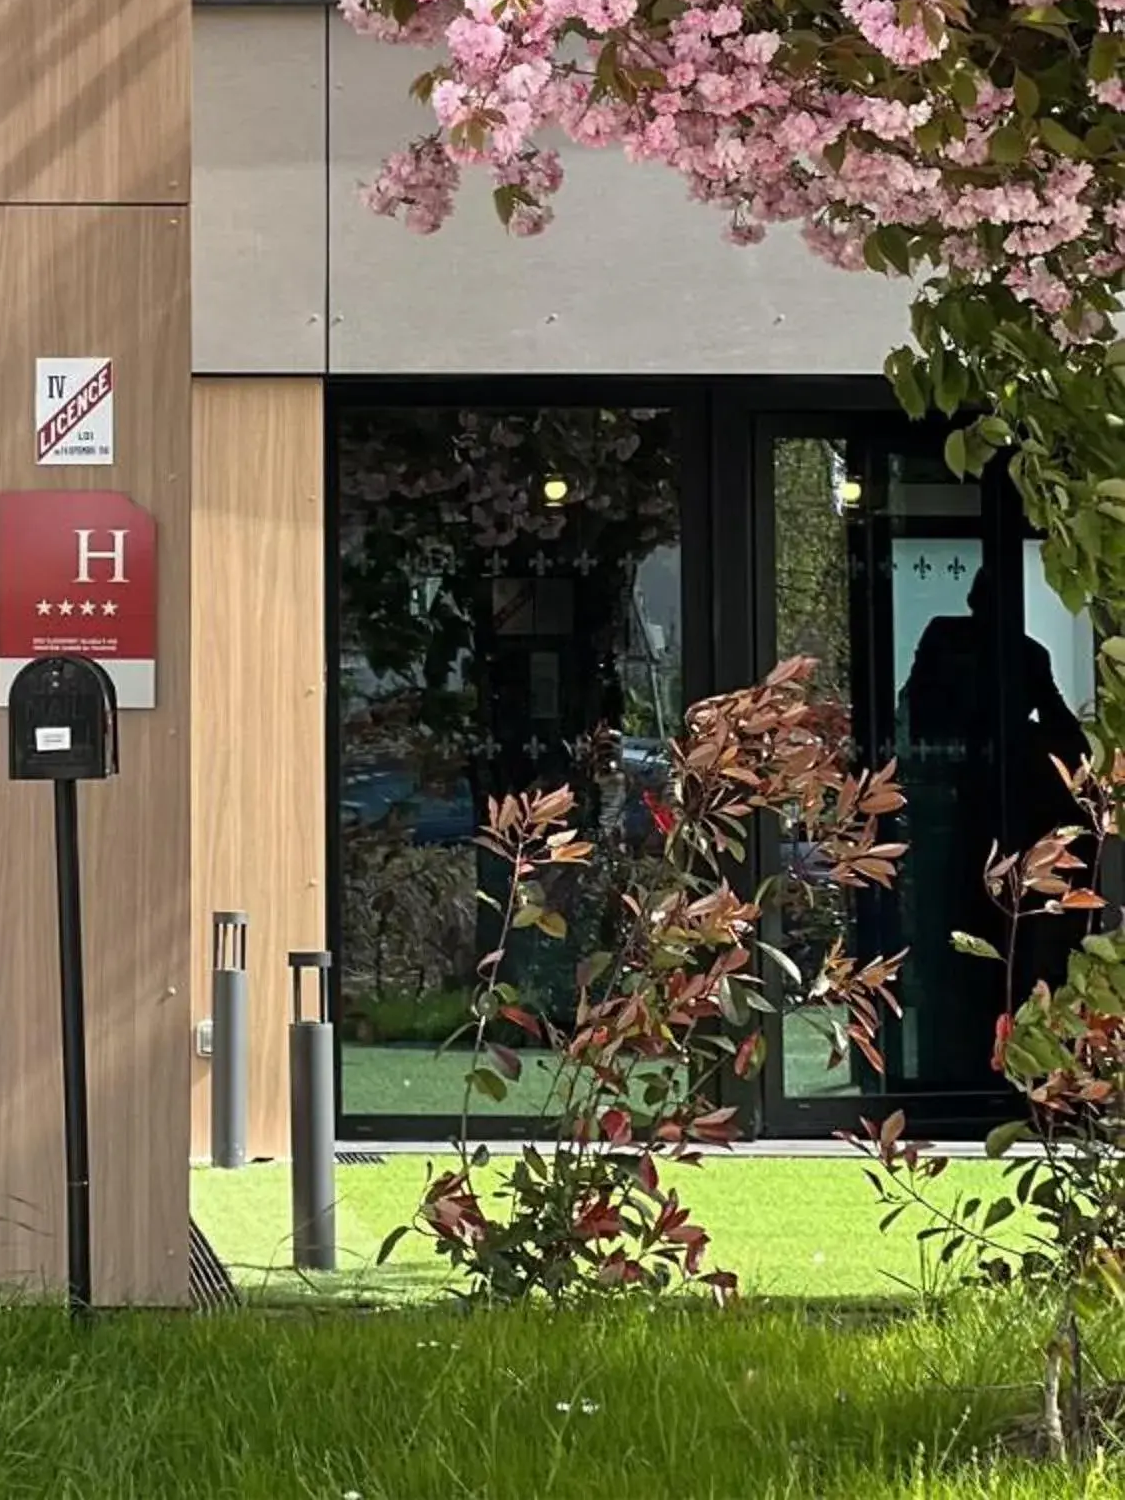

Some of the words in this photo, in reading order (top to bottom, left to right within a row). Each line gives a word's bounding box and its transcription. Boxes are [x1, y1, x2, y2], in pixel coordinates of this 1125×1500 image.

[40, 368, 109, 456] LICENCE
[47, 375, 67, 399] IV
[73, 529, 131, 583] H
